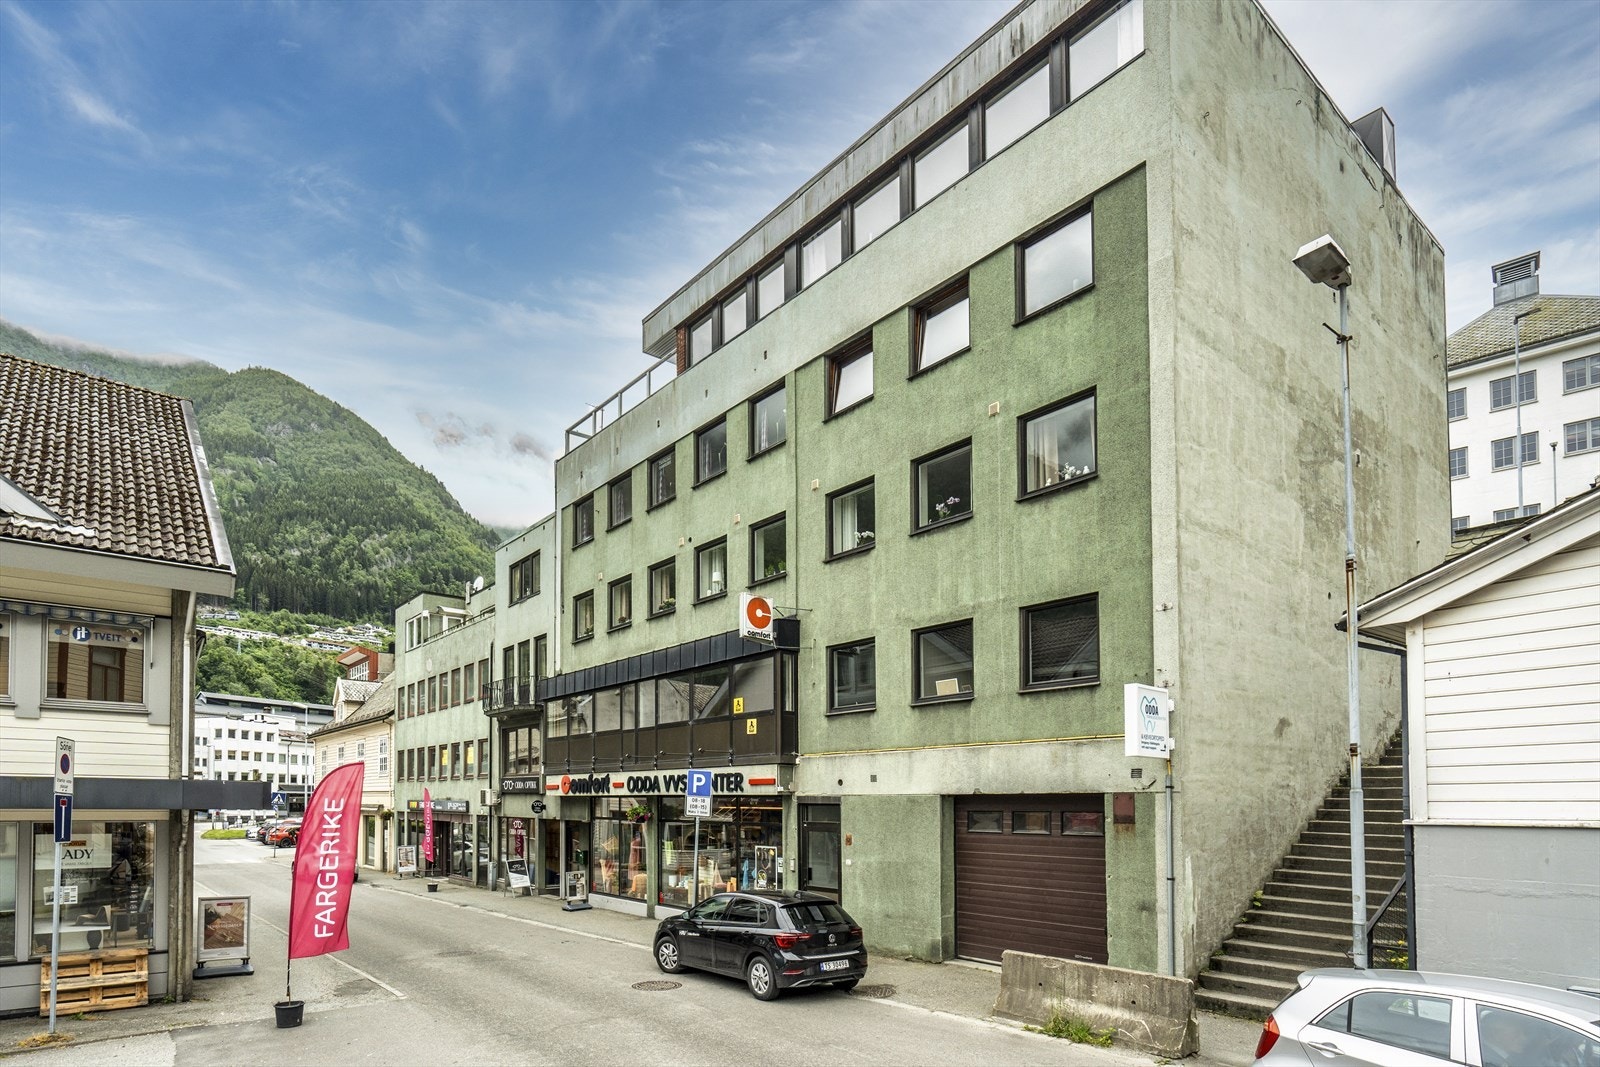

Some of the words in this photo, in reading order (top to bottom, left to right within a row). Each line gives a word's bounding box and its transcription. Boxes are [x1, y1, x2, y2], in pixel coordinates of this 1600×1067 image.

[94, 632, 122, 642] TVEIT
[747, 630, 771, 639] comfort
[1145, 704, 1159, 715] ODDA
[59, 741, 72, 752] Sone
[627, 775, 661, 793] ODDA
[663, 774, 688, 793] VVS
[712, 772, 744, 793] NTER
[693, 773, 706, 793] P
[62, 848, 94, 860] ADY
[314, 797, 345, 938] FARGERIKE
